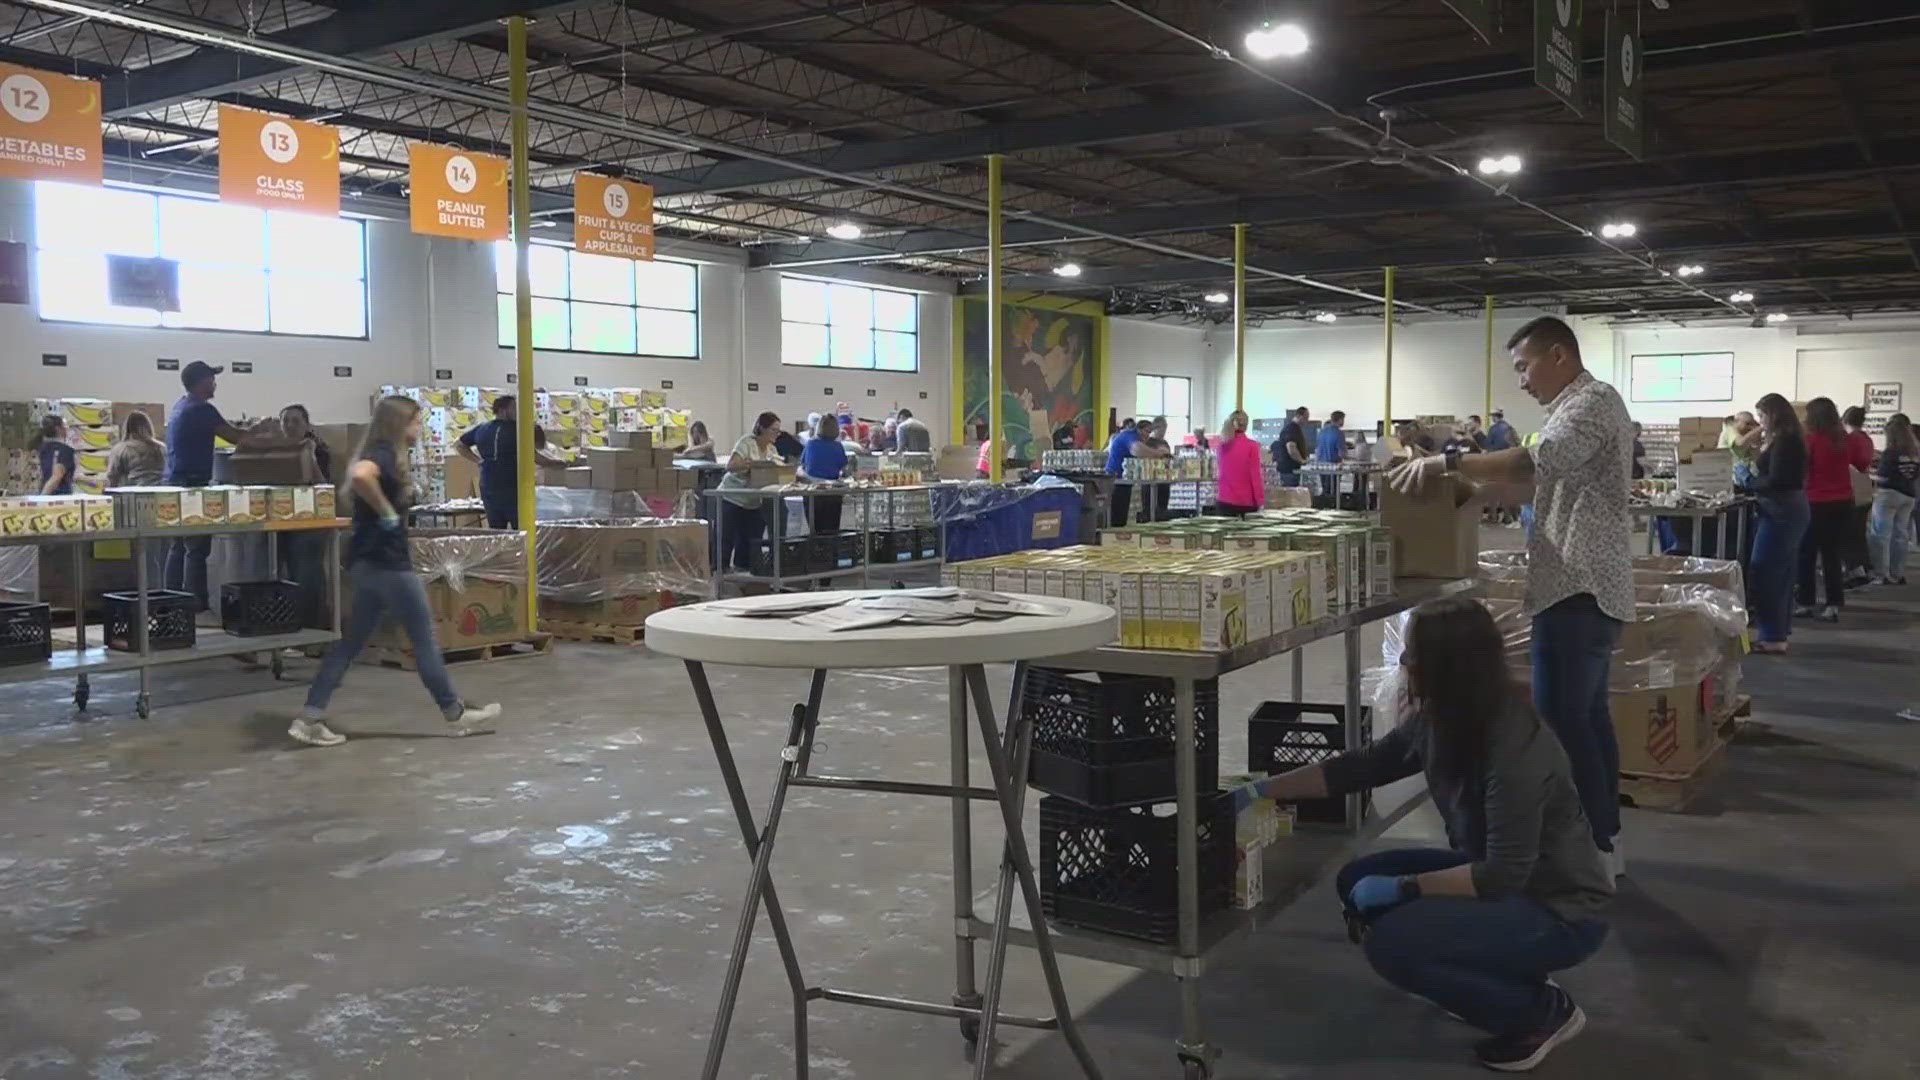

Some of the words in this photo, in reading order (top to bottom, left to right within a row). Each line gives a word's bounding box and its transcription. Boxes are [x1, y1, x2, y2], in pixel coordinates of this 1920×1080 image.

[1555, 72, 1572, 97] SOUP
[11, 87, 39, 110] 12
[269, 132, 290, 152] 13
[256, 174, 304, 193] GLASS
[452, 165, 470, 184] 14
[437, 199, 486, 216] PEANUT
[609, 193, 623, 209] 15
[438, 213, 486, 229] BUTTER
[578, 215, 608, 229] FRUIT
[609, 219, 616, 229] &
[617, 220, 651, 235] VEGGIE
[600, 229, 626, 243] CUPS
[627, 233, 633, 244] &
[584, 239, 647, 257] APPLESAUCE
